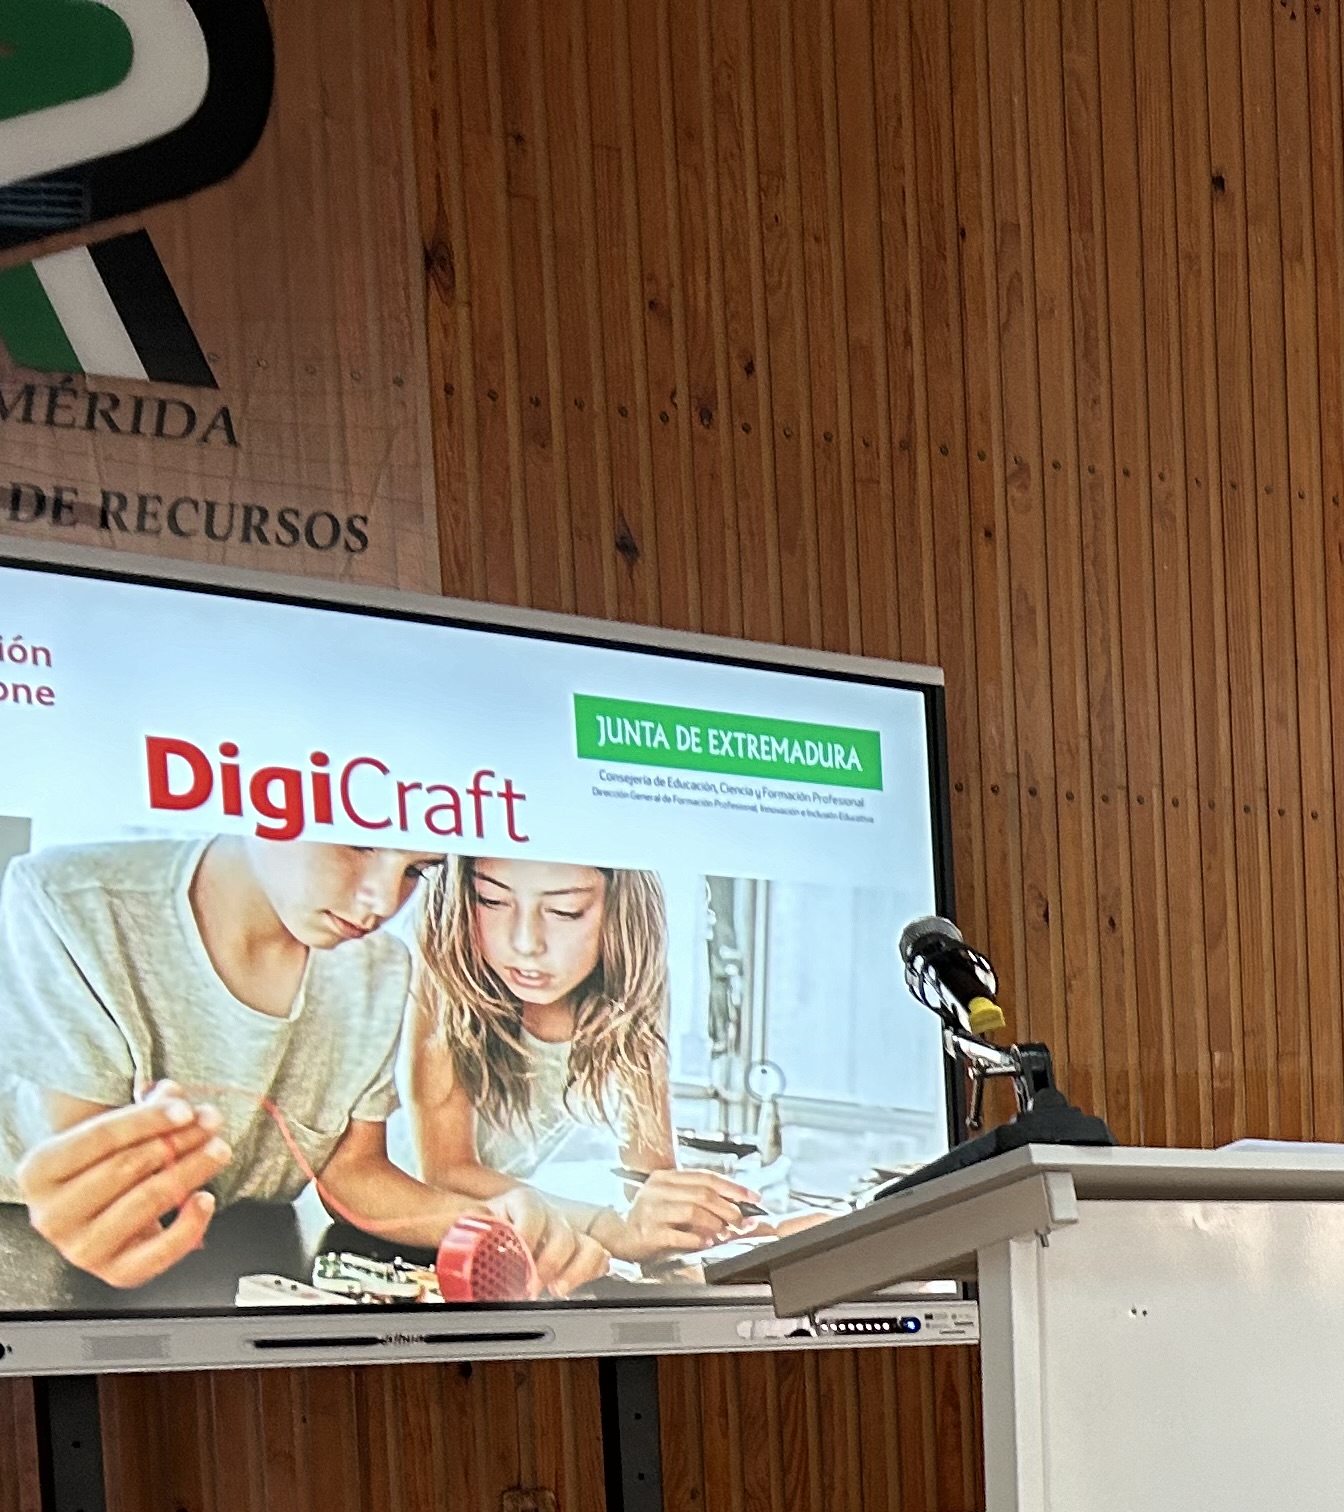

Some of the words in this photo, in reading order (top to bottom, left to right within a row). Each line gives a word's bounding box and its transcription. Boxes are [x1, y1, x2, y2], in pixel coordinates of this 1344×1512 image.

[8, 481, 79, 528] DE
[99, 488, 370, 553] RECURSOS
[595, 714, 670, 750] JUNTA
[675, 724, 703, 754] DE
[707, 728, 864, 773] EXTREMADURA
[145, 733, 531, 844] DigiCraft
[653, 775, 666, 788] de
[719, 781, 754, 797] Ciencia
[754, 789, 762, 800] y
[762, 786, 812, 803] Formación
[812, 791, 865, 808] Profesional
